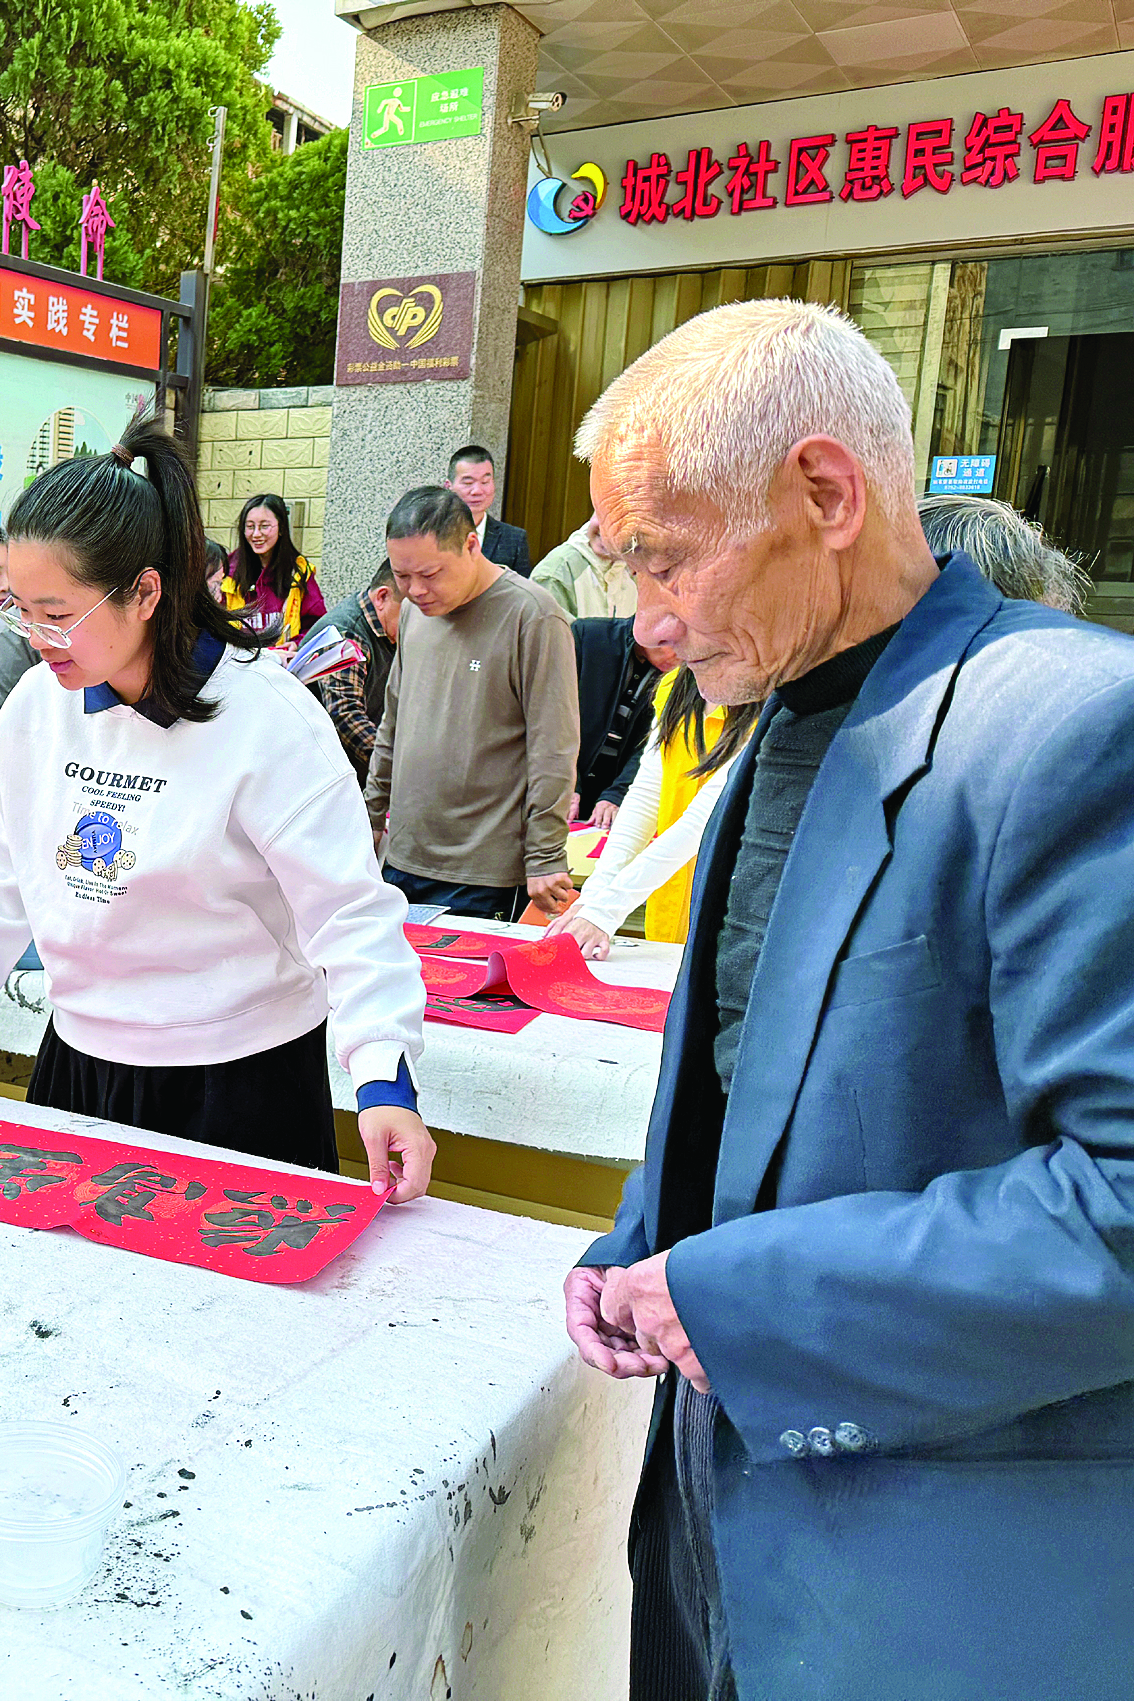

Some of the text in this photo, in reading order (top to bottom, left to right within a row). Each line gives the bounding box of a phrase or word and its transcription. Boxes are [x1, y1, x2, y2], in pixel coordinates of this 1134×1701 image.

[64, 762, 168, 793] GOURMET
[81, 785, 142, 802] COOL FEELING
[89, 799, 126, 812] SPEEDY!
[98, 812, 110, 824] to
